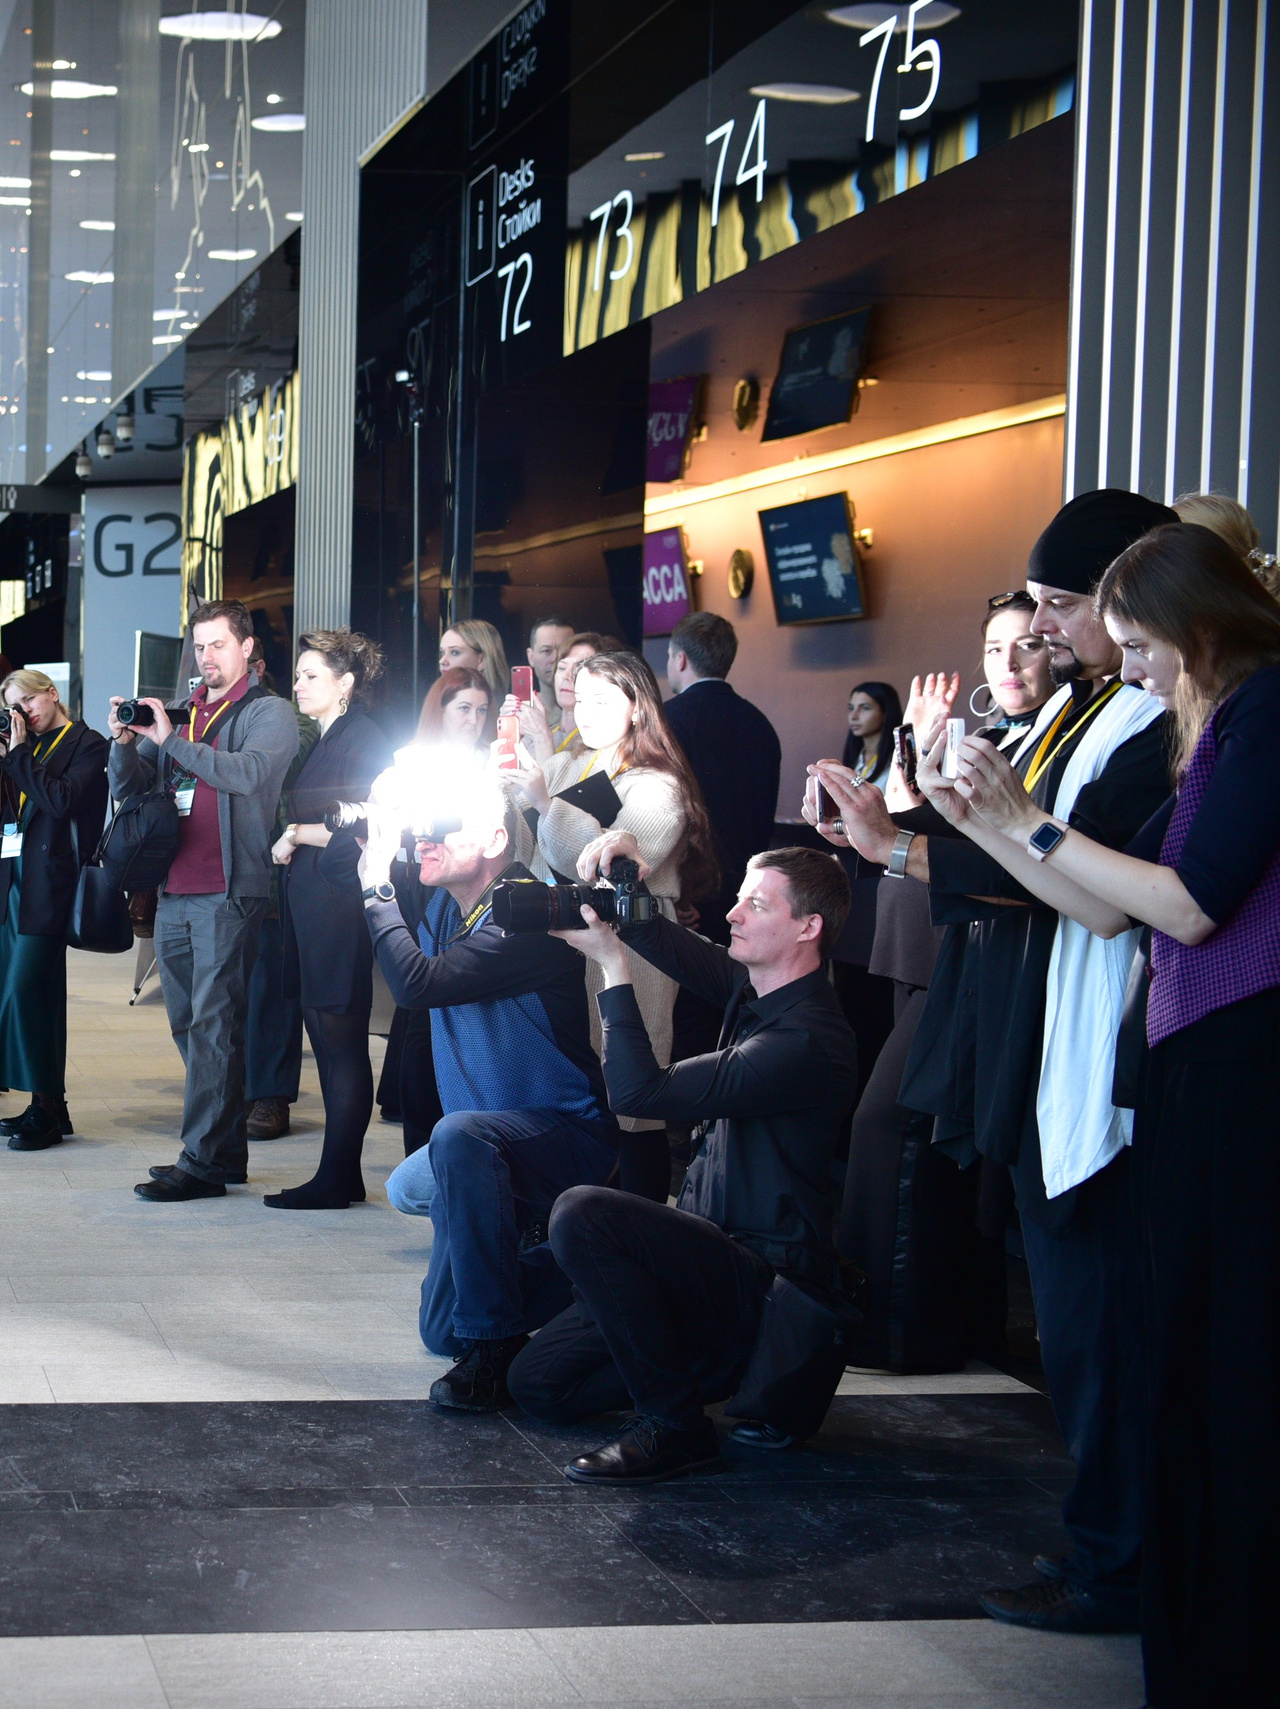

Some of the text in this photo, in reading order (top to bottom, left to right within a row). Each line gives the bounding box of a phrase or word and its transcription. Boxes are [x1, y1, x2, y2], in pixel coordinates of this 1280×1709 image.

[859, 0, 941, 143] 75
[498, 157, 535, 208] Desks
[706, 98, 768, 227] 74
[497, 197, 542, 249] Стойки
[589, 190, 634, 291] 73
[497, 251, 533, 343] 72
[93, 512, 182, 578] G2
[465, 904, 484, 927] Nikon
